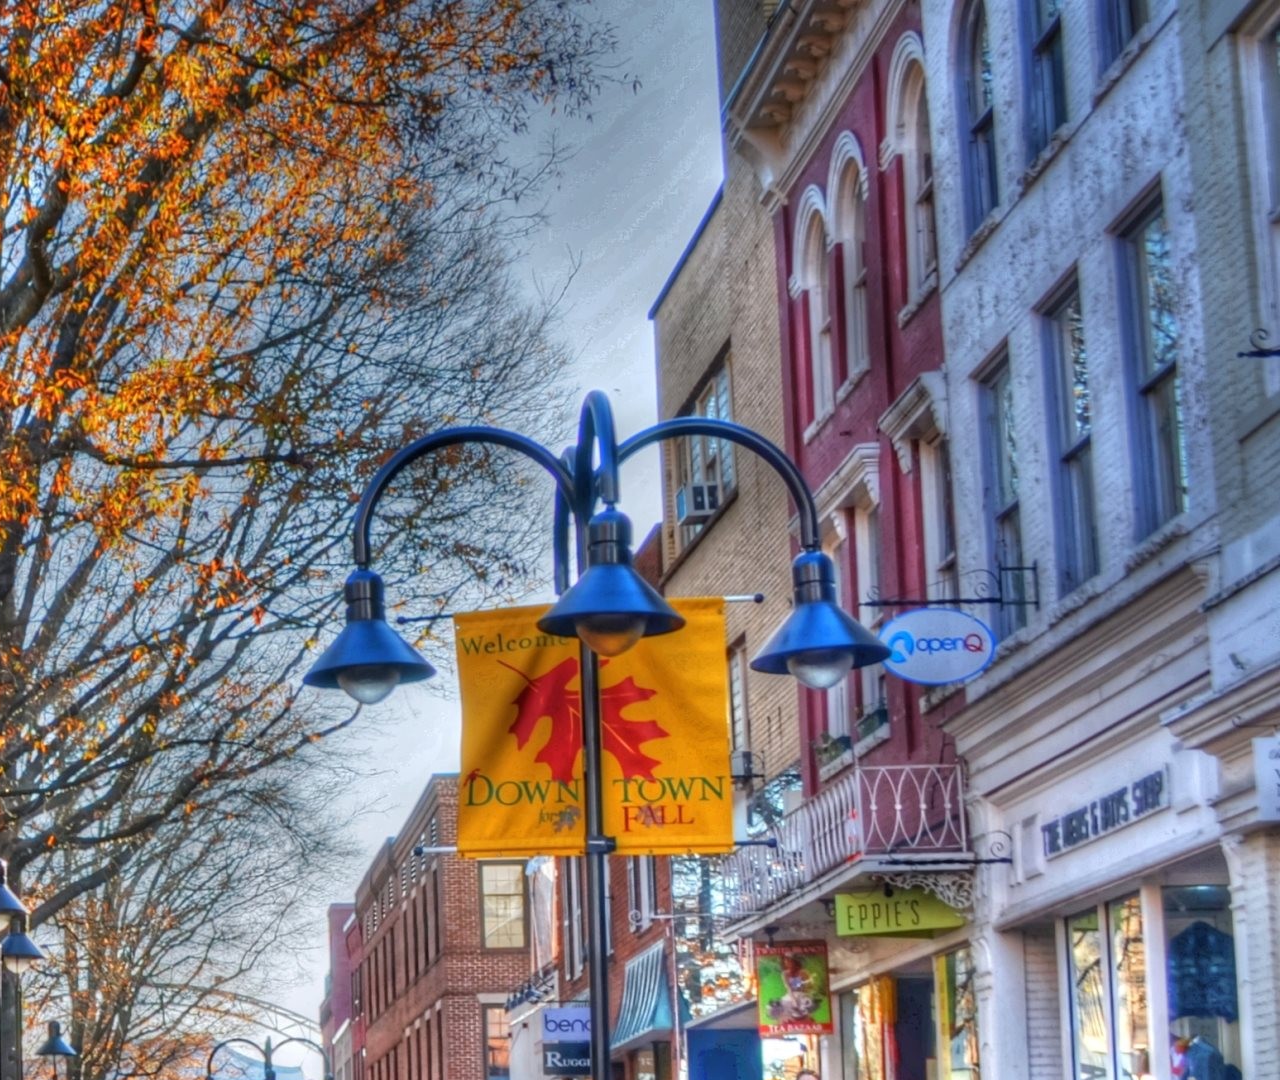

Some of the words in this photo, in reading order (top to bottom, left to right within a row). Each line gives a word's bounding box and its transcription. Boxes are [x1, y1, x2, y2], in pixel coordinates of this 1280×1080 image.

[459, 633, 570, 656] Welcome
[916, 633, 983, 655] openQ
[466, 775, 581, 807] DOWN
[613, 775, 726, 803] TOWN
[1132, 770, 1163, 817] SHOP
[621, 804, 695, 833] FALL
[846, 900, 921, 930] EPPIE'S
